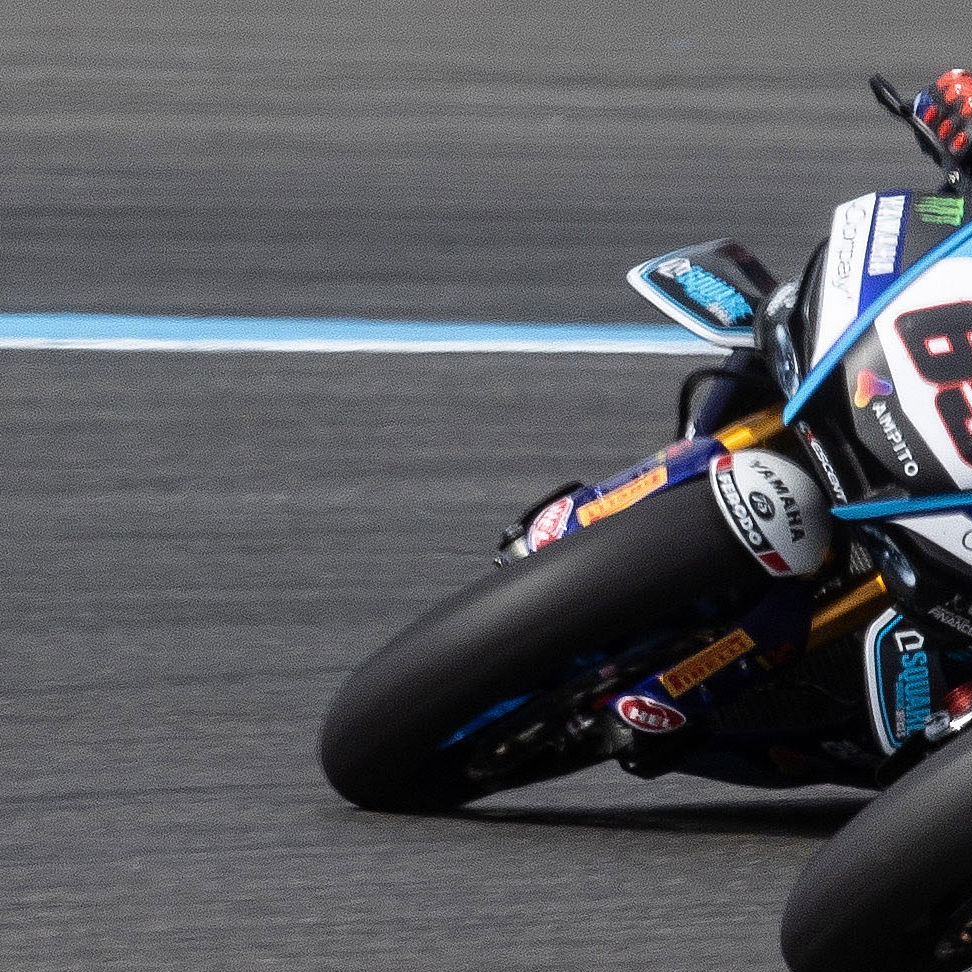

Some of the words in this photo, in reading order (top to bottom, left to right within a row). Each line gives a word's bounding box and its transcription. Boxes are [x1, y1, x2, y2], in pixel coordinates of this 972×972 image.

[872, 402, 920, 477] AMPITO
[717, 471, 763, 546] FERODO
[751, 460, 806, 543] YAMAHA
